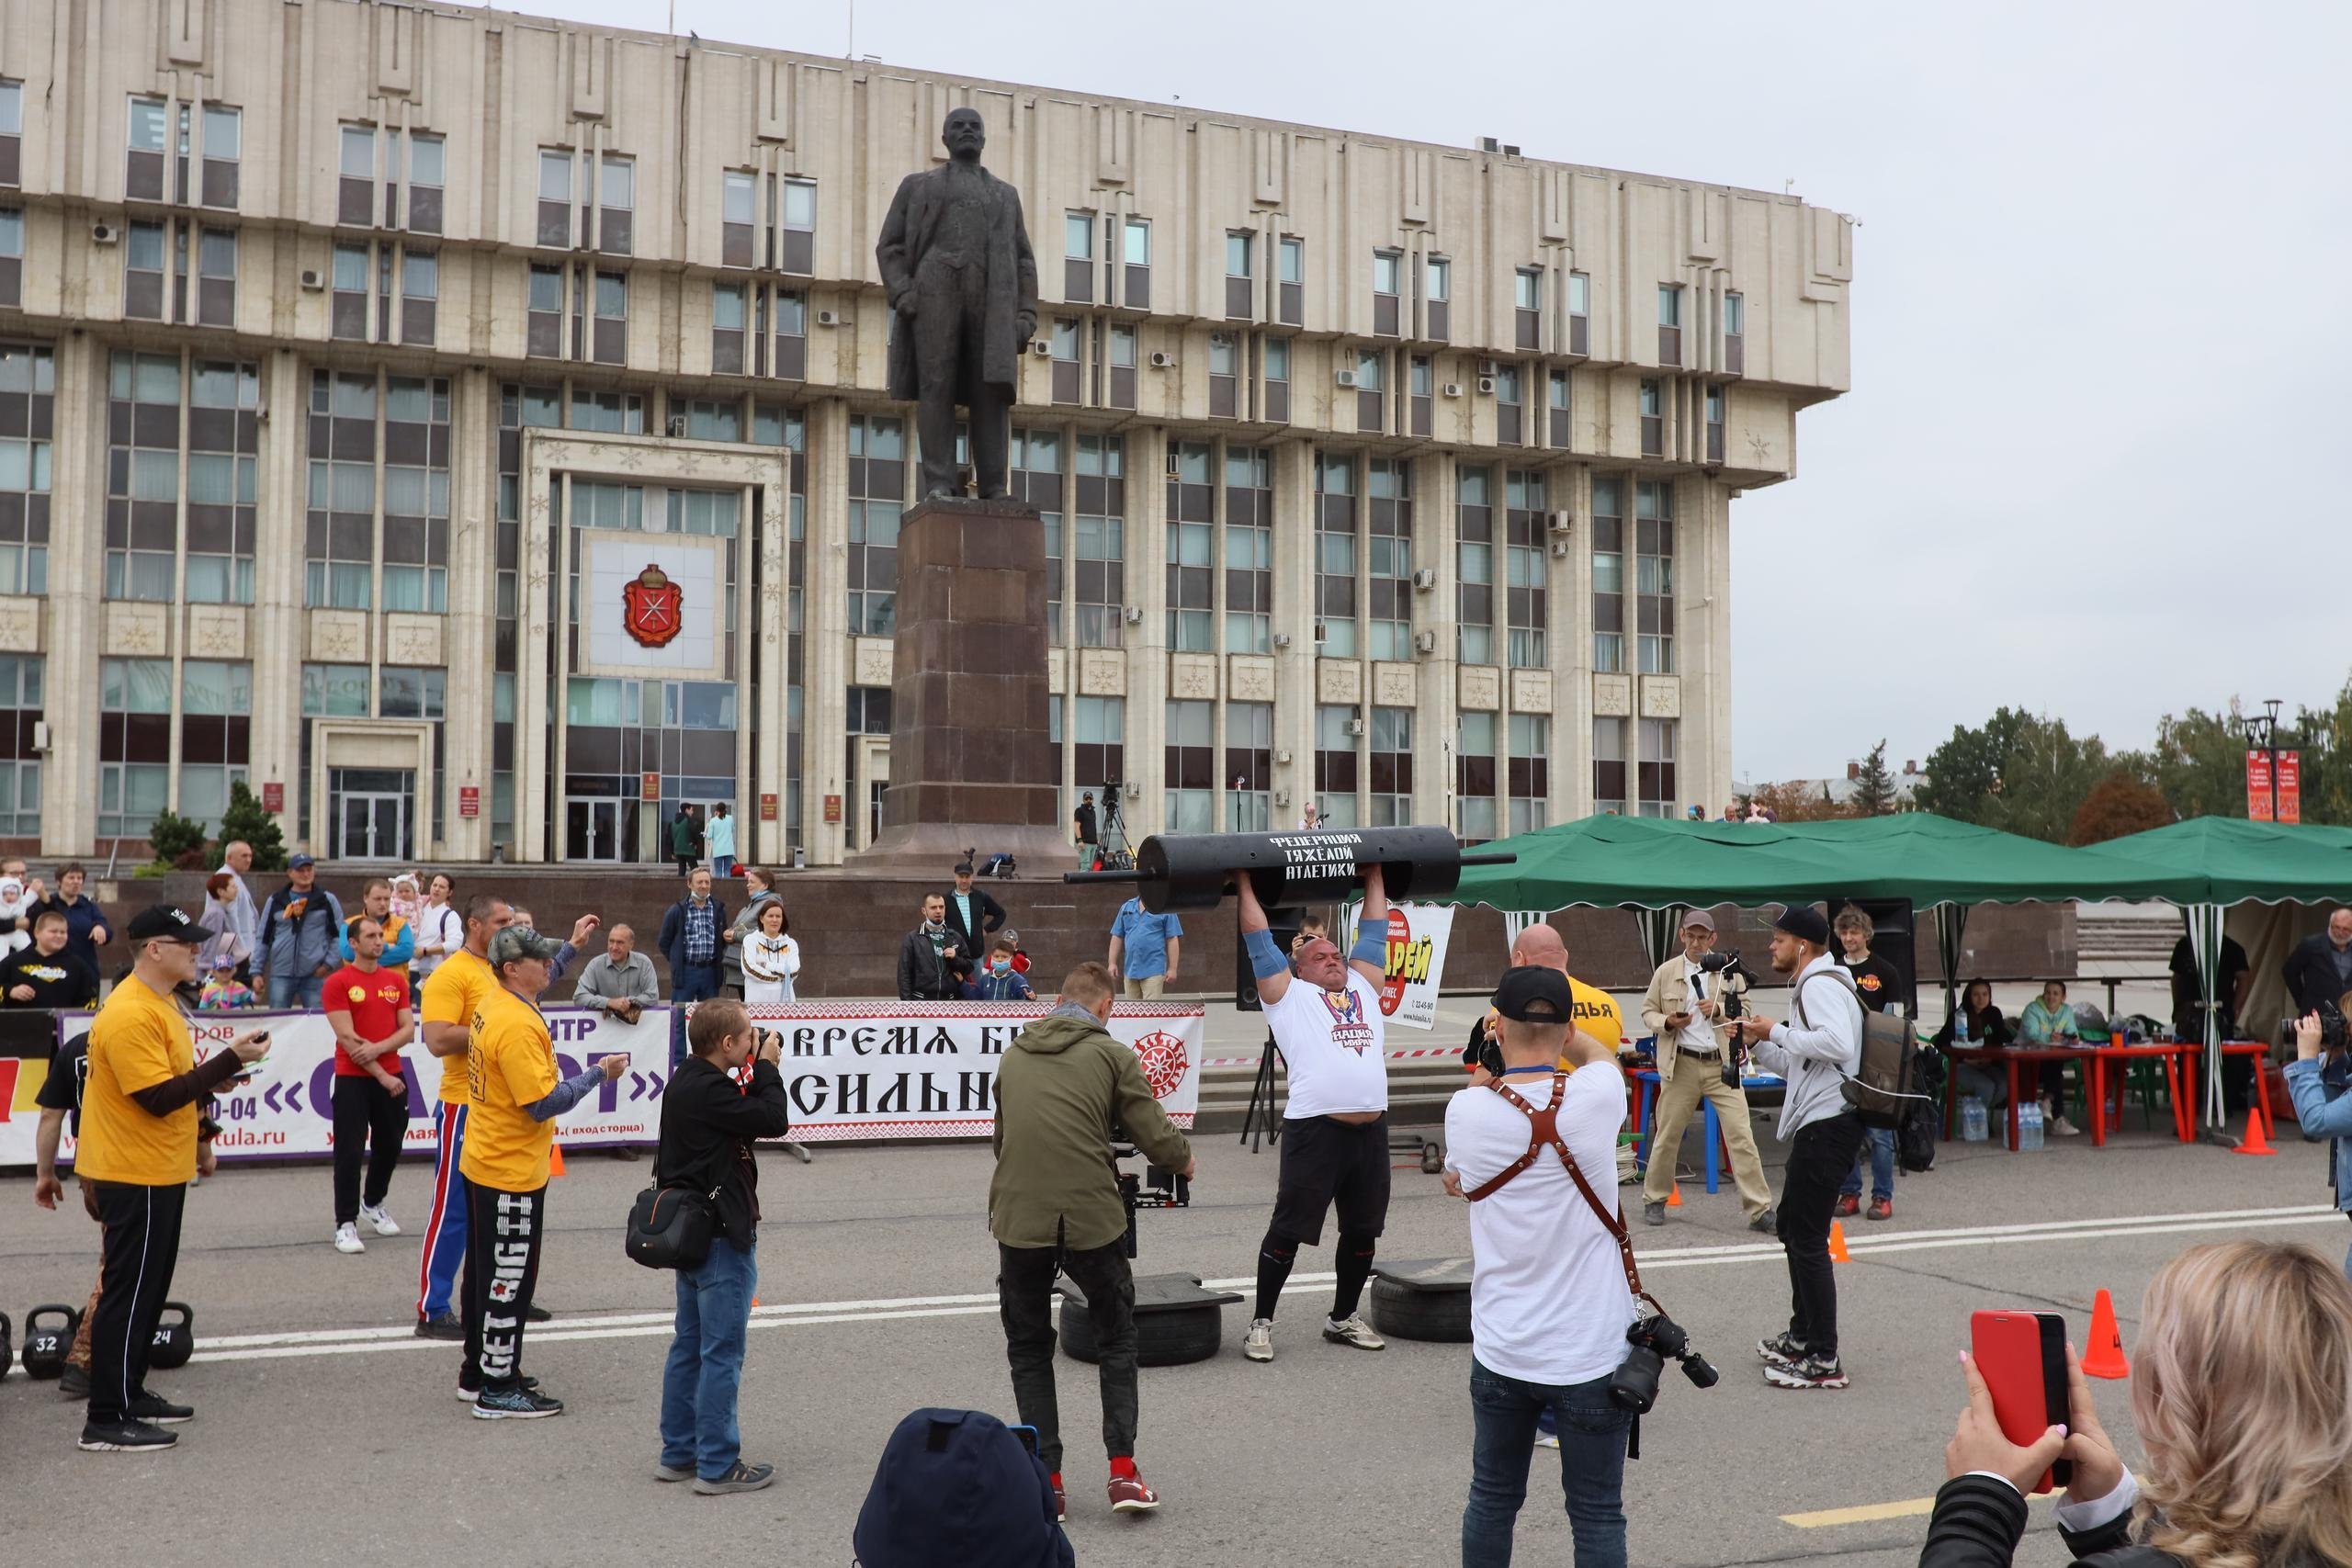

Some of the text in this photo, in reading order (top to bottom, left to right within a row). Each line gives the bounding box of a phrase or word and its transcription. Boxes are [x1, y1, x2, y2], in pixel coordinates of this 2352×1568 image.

[1269, 833, 1363, 848] ФЕДЕРАЦИЯ
[1284, 844, 1354, 863] ТЯЖЁЛОЙ
[1285, 863, 1356, 880] АТЛЕТИКИ
[1572, 1001, 1613, 1020] ДЬЯ
[790, 1026, 959, 1057] ВРЕМЯ
[789, 1071, 993, 1116] СИЛЬН
[208, 1096, 257, 1121] 0-04
[214, 1127, 286, 1147] tula.ru
[572, 1126, 599, 1135] вход
[607, 1122, 645, 1134] торца)
[479, 1241, 530, 1378] GET BIG
[35, 1336, 58, 1353] 32
[152, 1329, 172, 1346] 24
